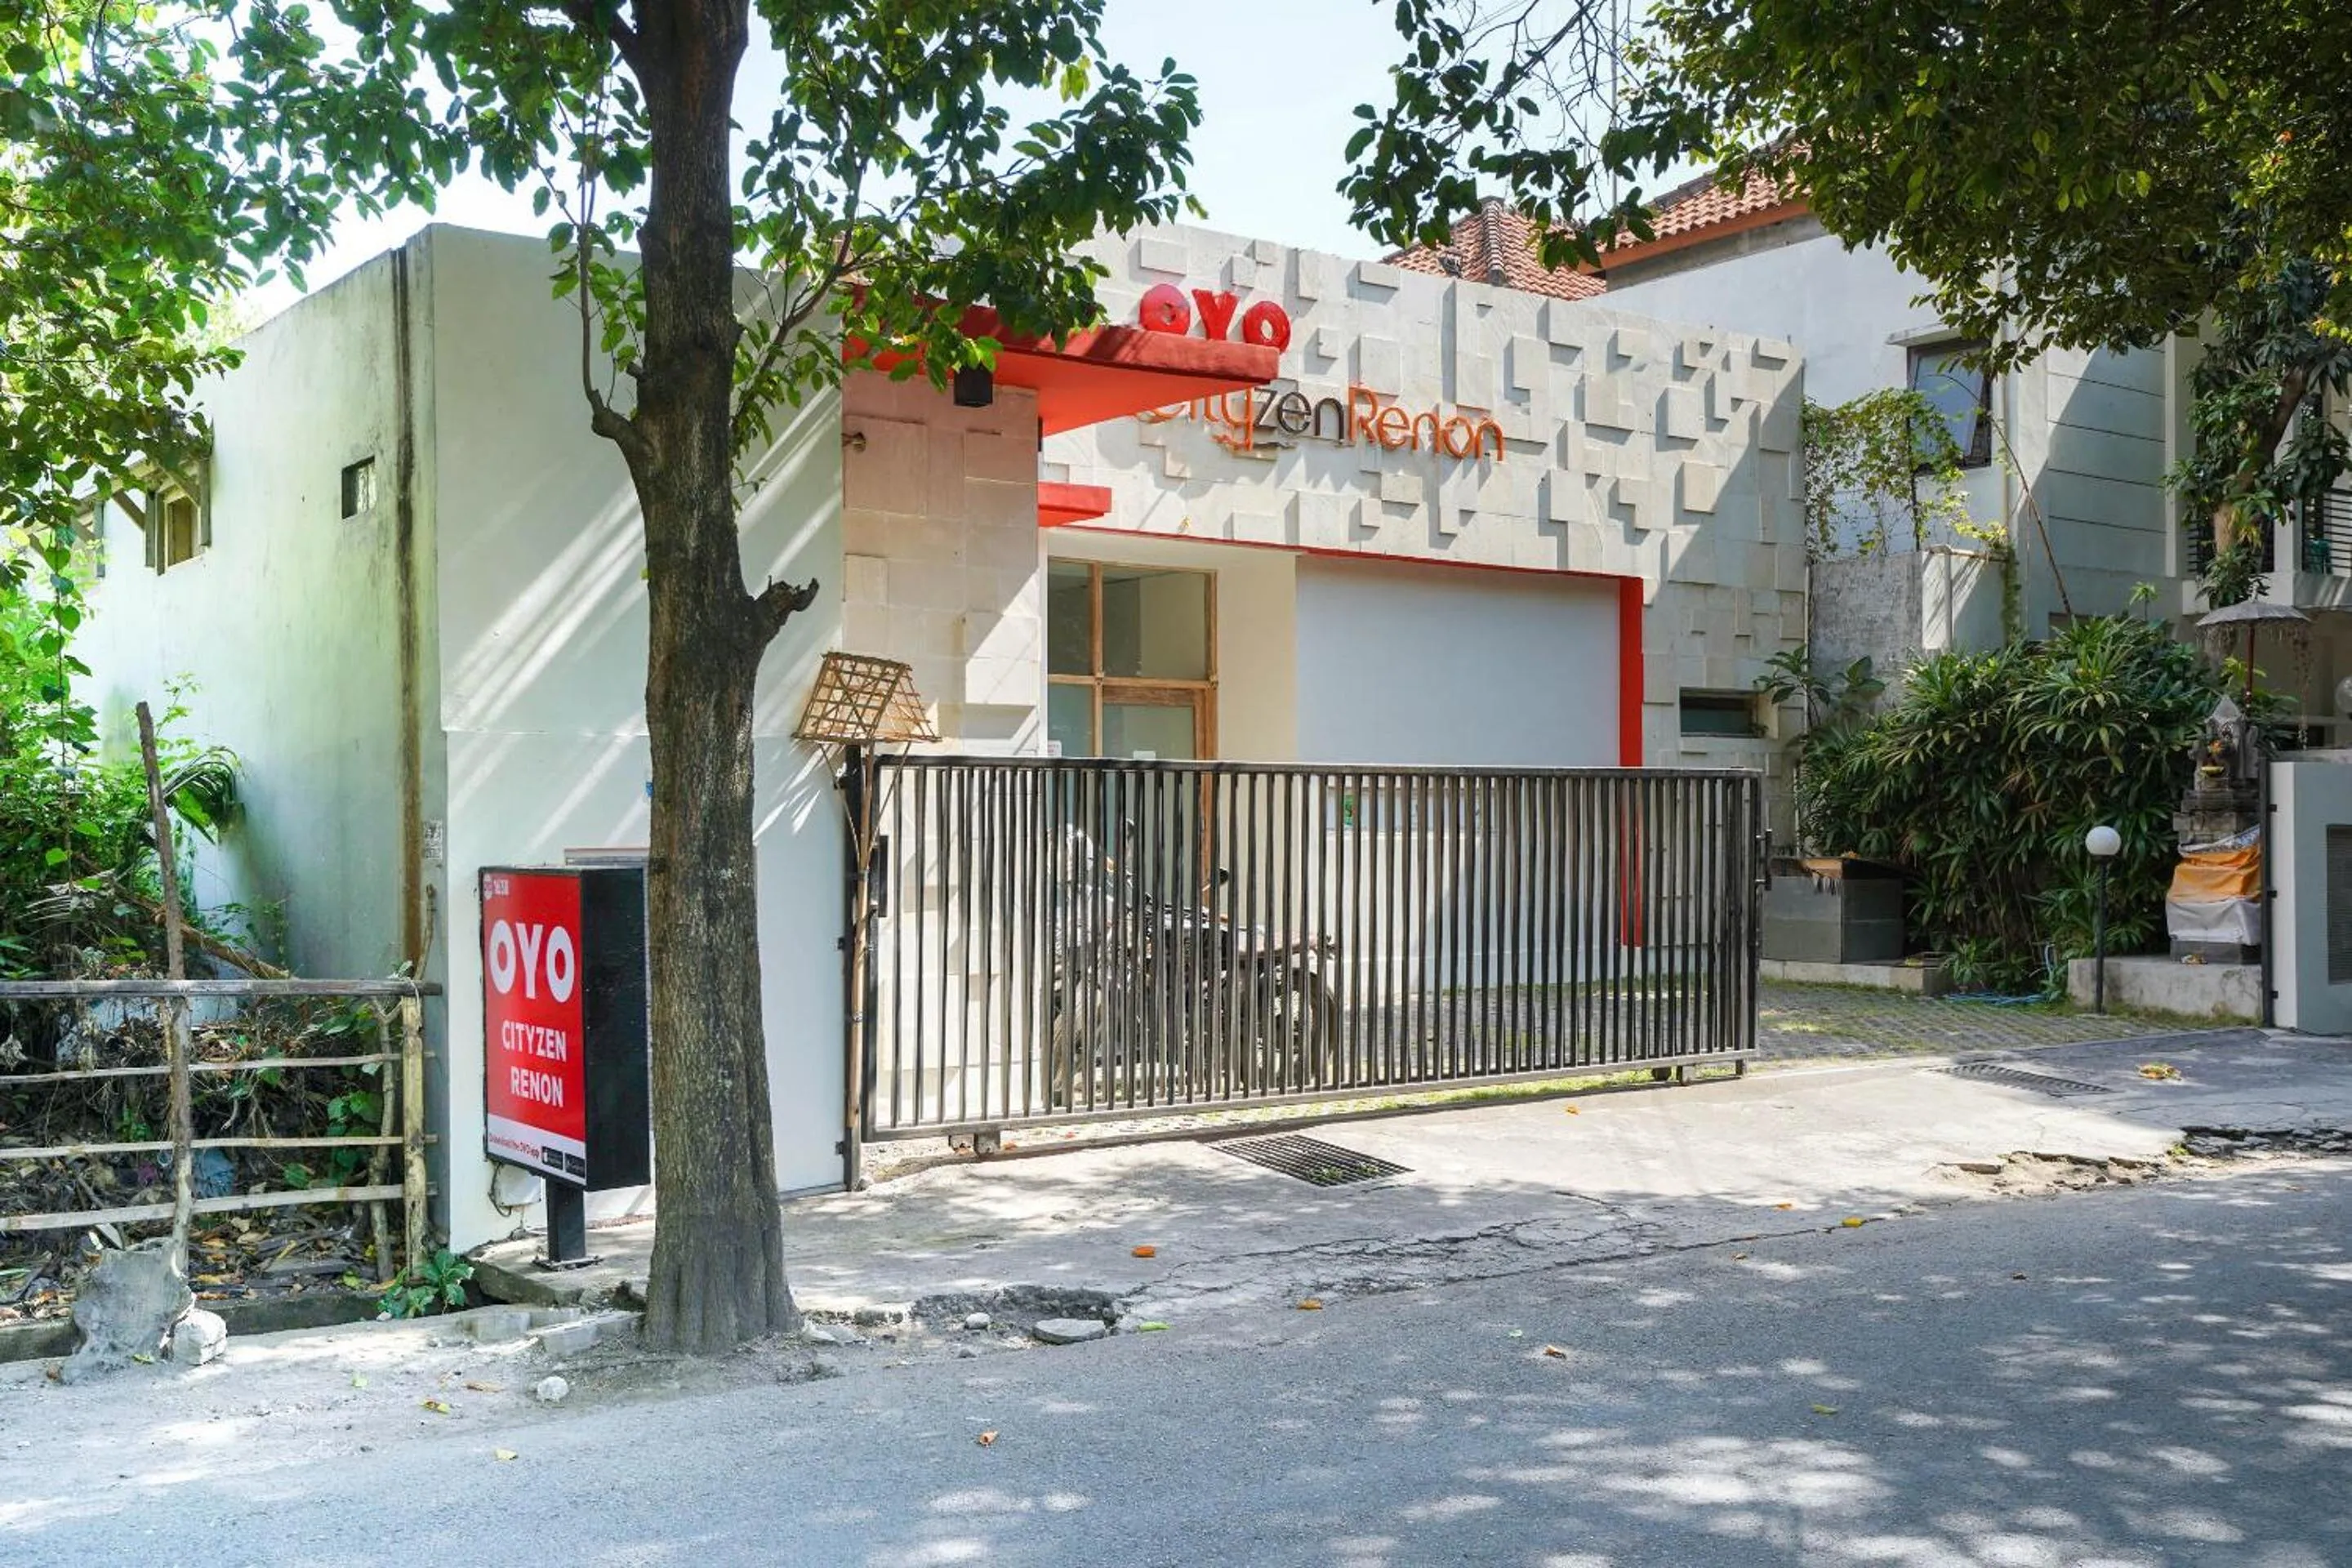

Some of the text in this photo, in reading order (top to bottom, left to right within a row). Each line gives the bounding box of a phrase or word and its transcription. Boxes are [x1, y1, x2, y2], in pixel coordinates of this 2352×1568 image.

[1139, 283, 1290, 354] OYO
[489, 919, 575, 1003] OYO
[502, 1019, 567, 1062] CITYZEN
[510, 1065, 564, 1107] RENON
